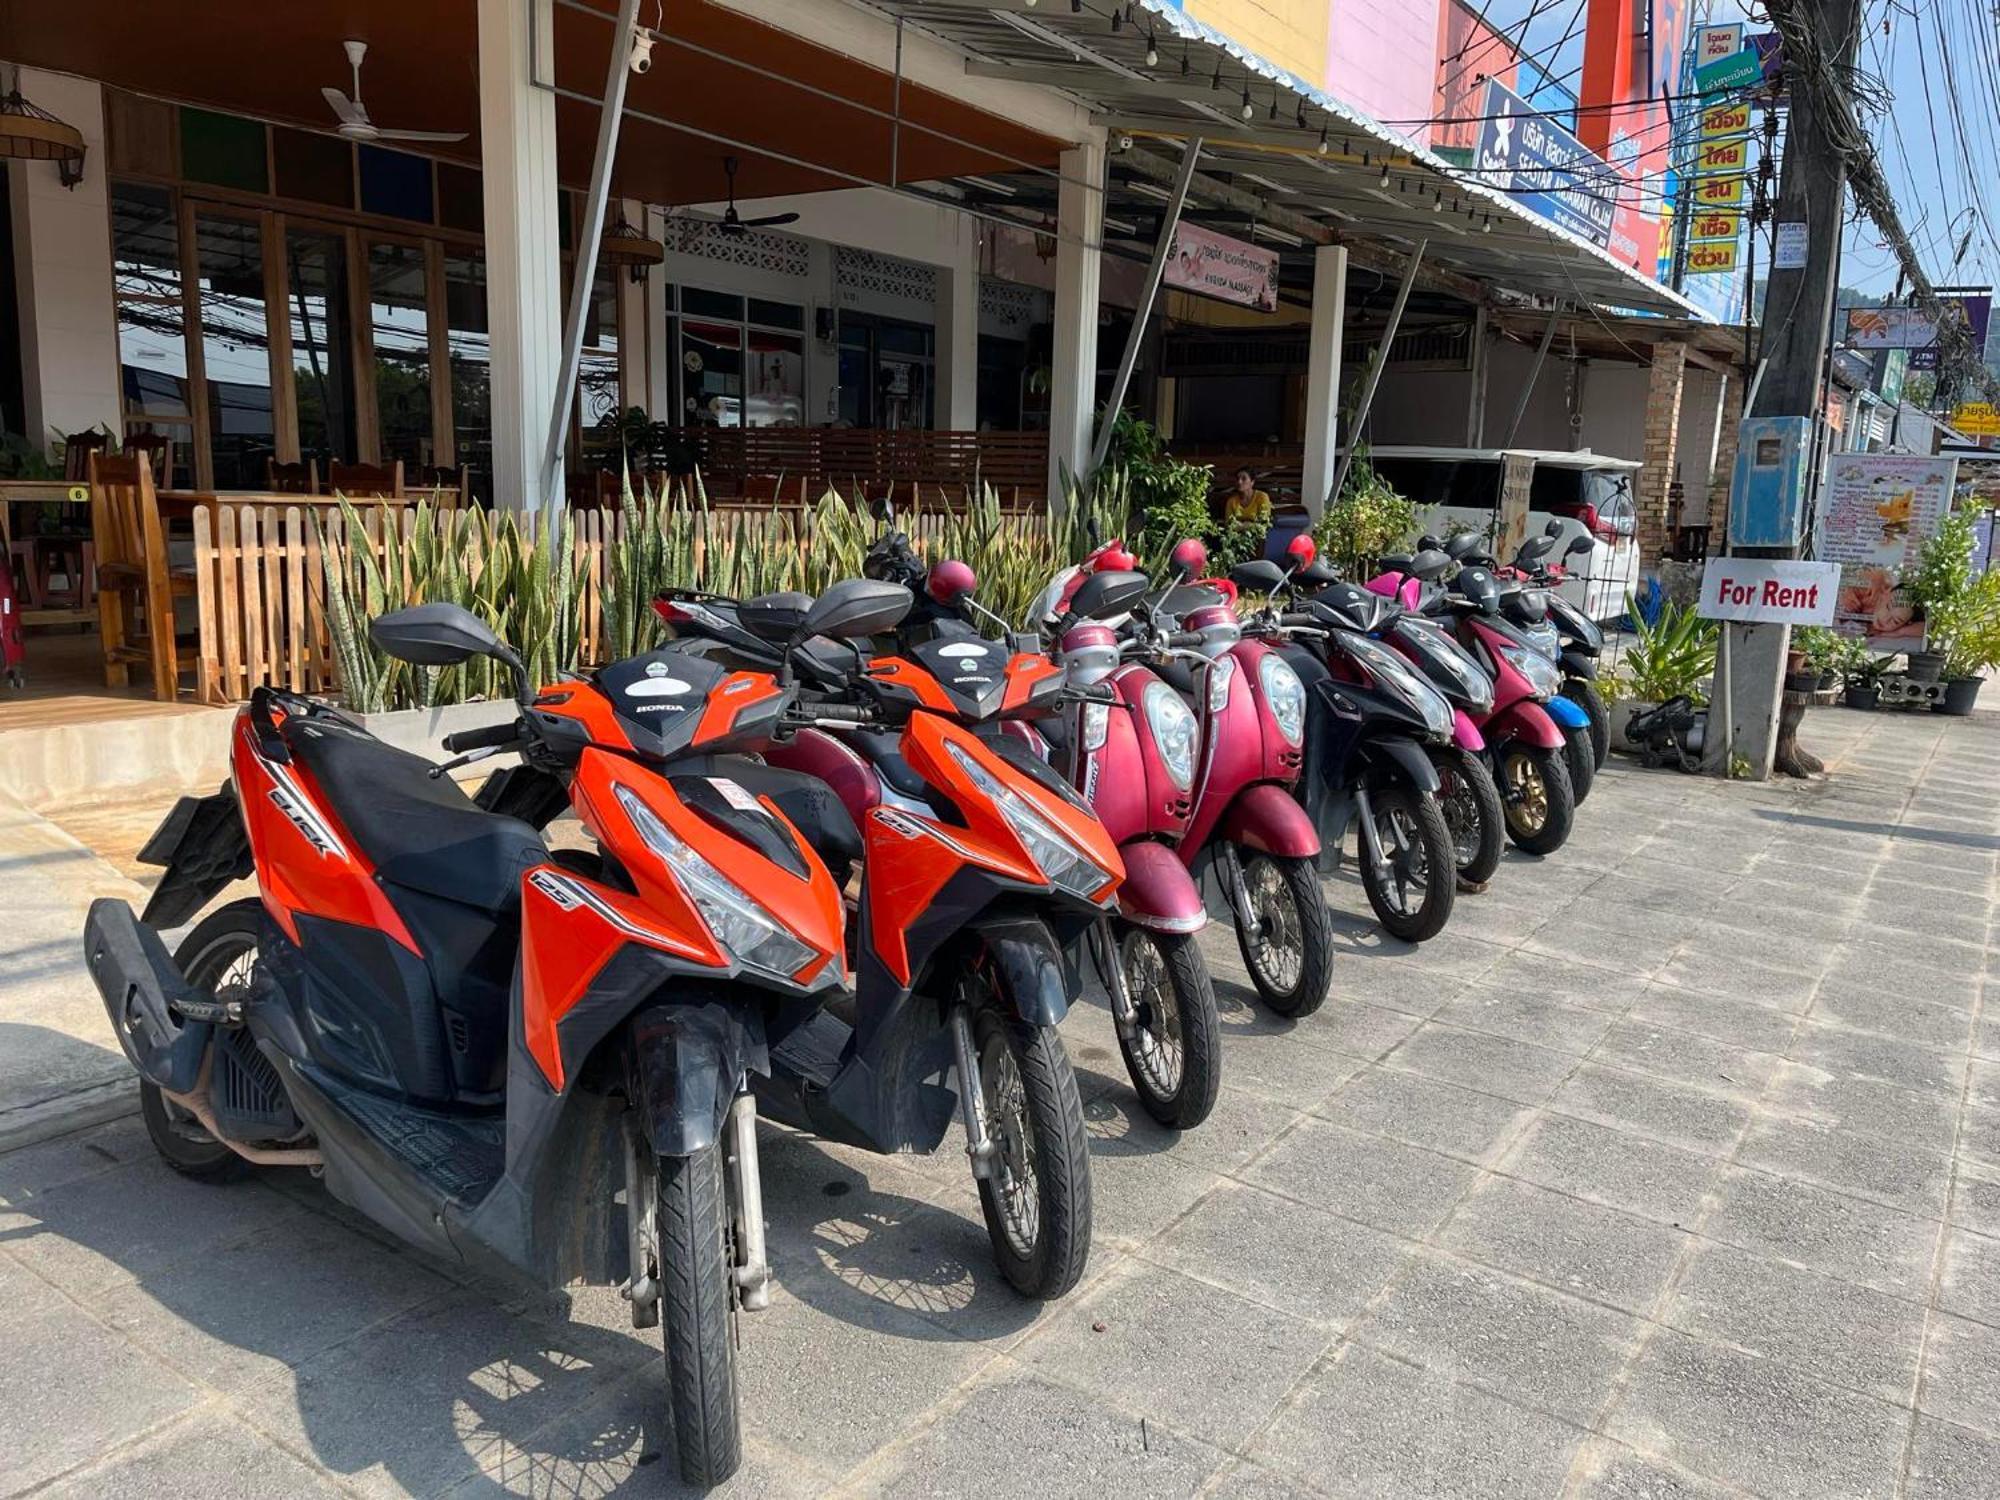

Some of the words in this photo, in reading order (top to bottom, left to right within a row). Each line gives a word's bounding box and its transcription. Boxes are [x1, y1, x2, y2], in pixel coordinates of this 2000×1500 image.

[1705, 145, 1739, 166] ไทย
[1704, 179, 1732, 199] สิน
[1692, 246, 1730, 268] ด่วน
[1718, 578, 1757, 605] For
[1762, 580, 1818, 609] Rent
[636, 704, 686, 713] HONDA
